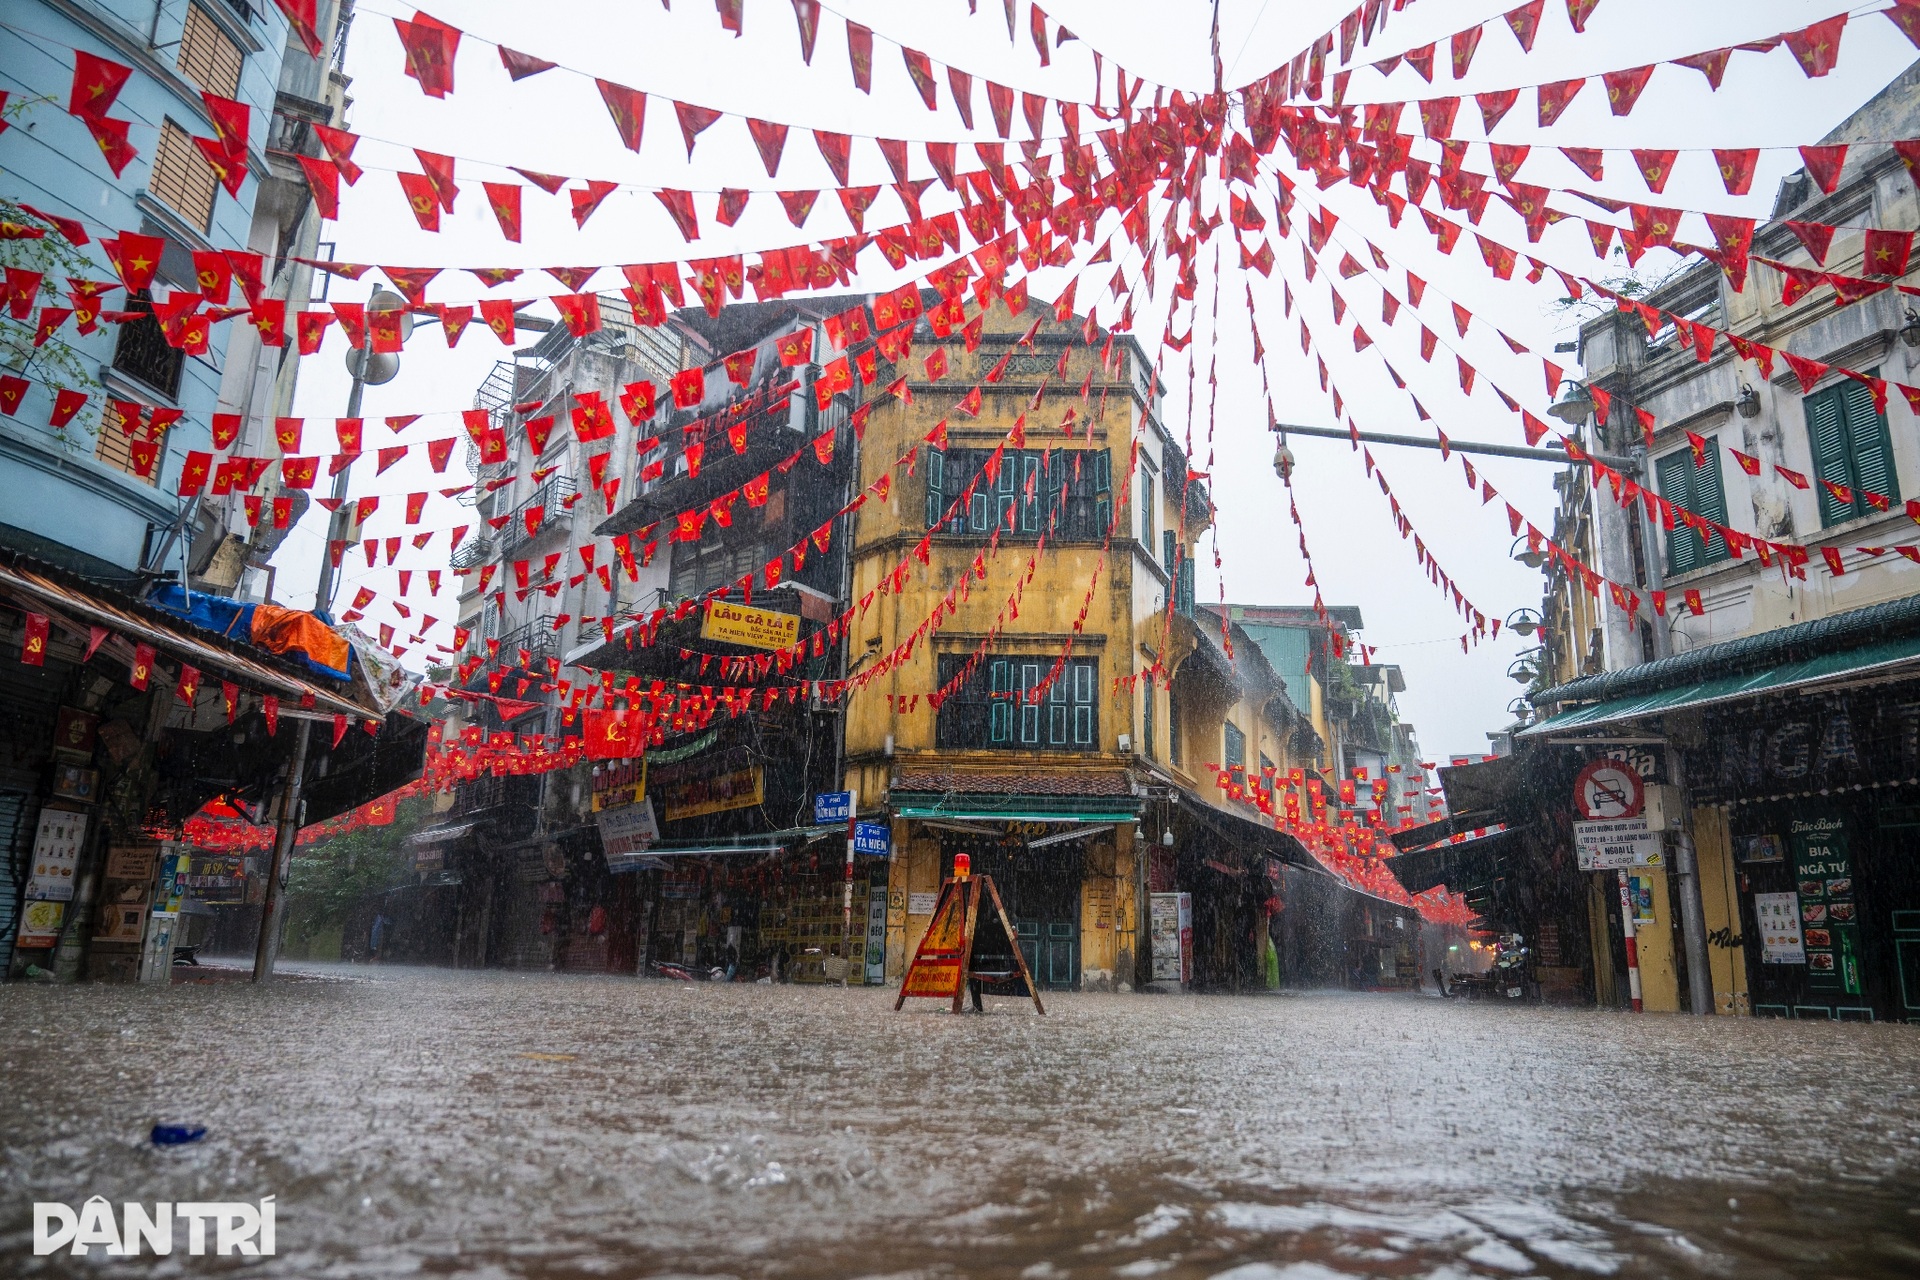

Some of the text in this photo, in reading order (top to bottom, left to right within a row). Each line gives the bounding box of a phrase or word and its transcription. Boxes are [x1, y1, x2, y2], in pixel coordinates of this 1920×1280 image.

[745, 614, 764, 626] GÀ
[1808, 846, 1832, 857] BIA
[1798, 859, 1847, 875] NGÃ TƯ
[871, 890, 886, 902] BEER
